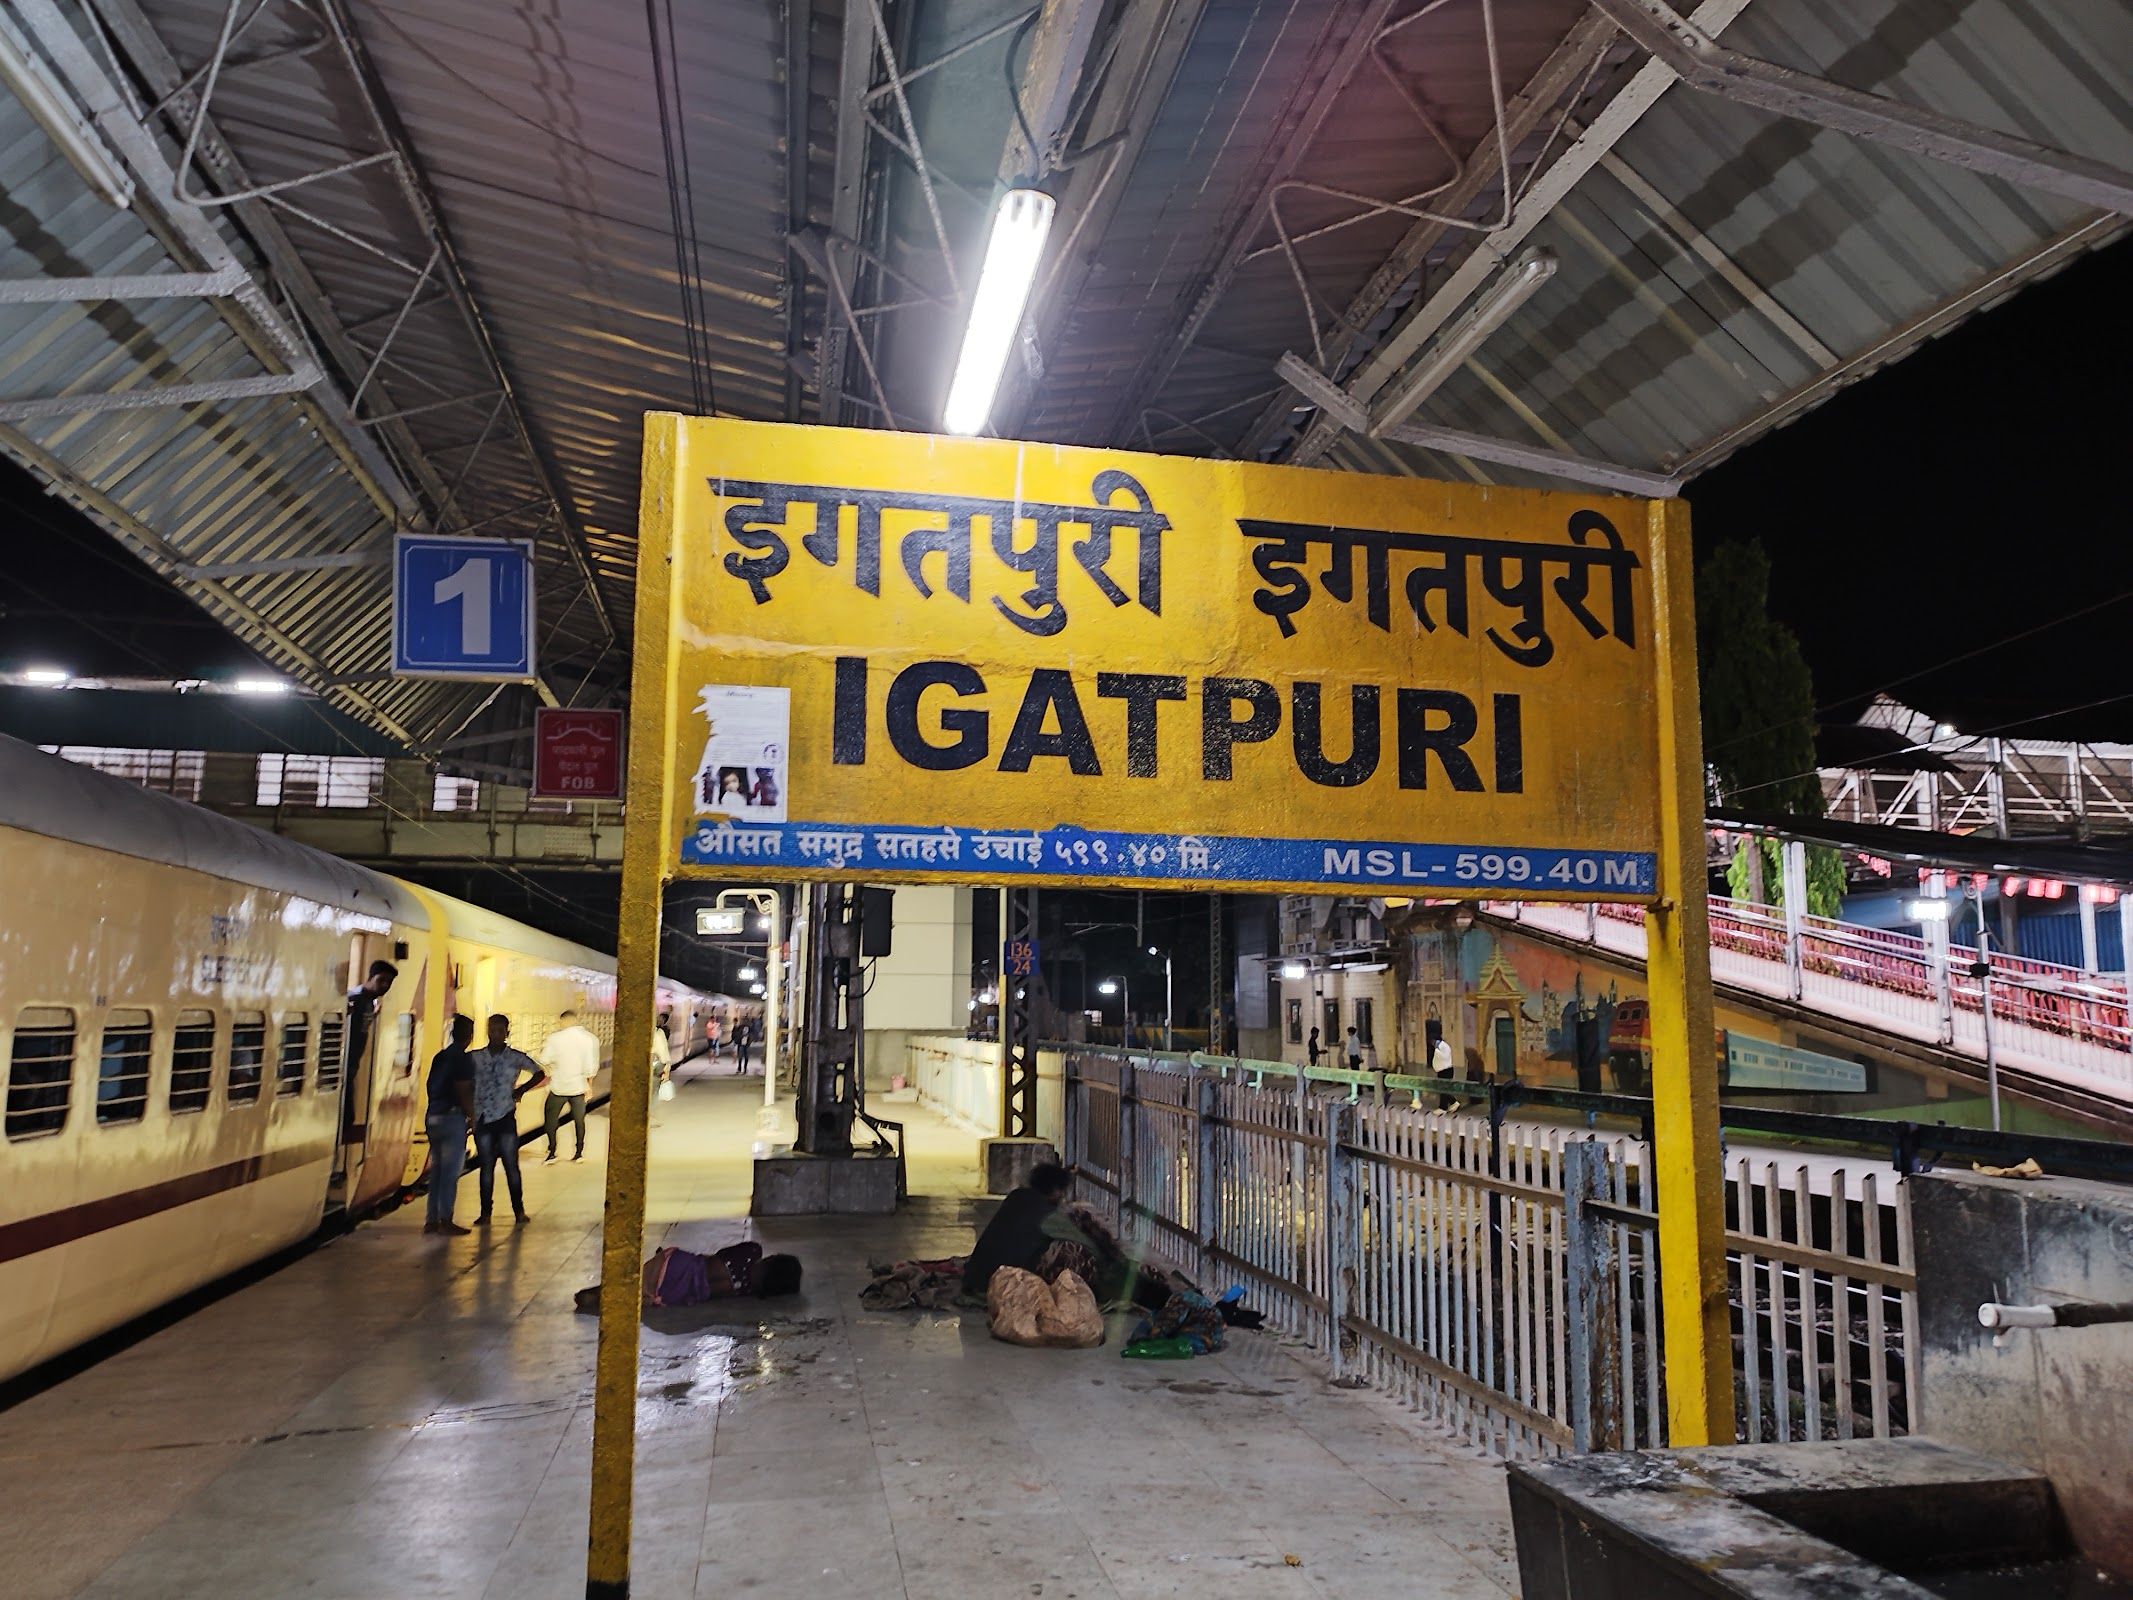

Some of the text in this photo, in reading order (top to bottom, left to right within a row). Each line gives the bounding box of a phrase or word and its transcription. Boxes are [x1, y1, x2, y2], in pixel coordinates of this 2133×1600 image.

[706, 469, 1172, 636] इगतपुरी
[1235, 509, 1642, 667] इगतपुरी
[434, 558, 491, 655] 1
[832, 656, 1524, 794] IGATPURI
[560, 775, 596, 789] FOB
[696, 821, 783, 857] औसत
[796, 831, 865, 869] समुद्र
[1010, 942, 1033, 957] 136
[1013, 959, 1031, 975] 24
